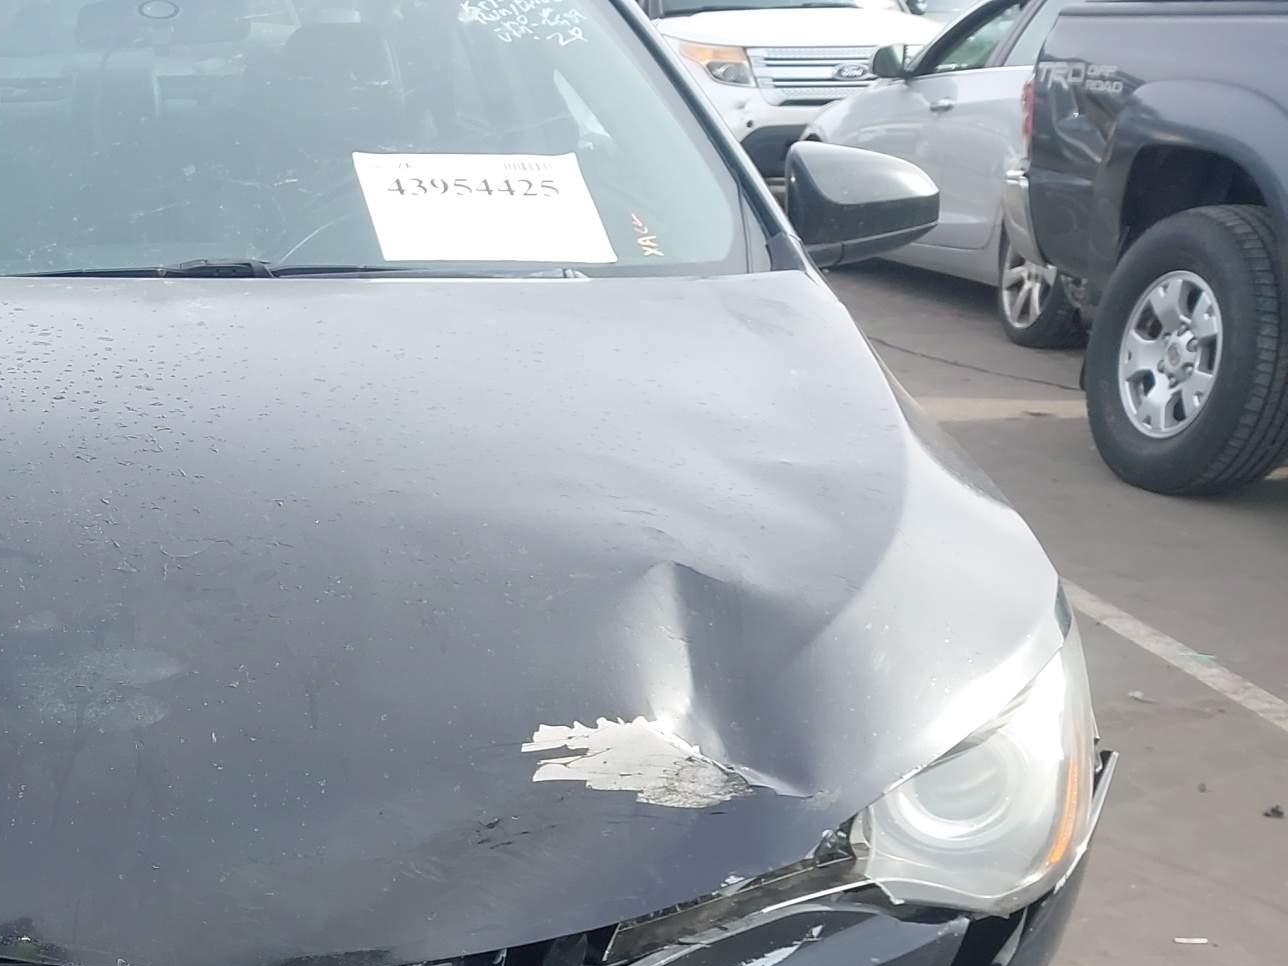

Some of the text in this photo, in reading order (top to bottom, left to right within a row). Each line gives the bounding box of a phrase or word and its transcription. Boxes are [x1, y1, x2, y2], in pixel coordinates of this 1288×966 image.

[1039, 62, 1085, 89] TRD
[1088, 65, 1118, 76] OFF
[1086, 80, 1123, 92] ROAD
[387, 178, 560, 197] 43954425
